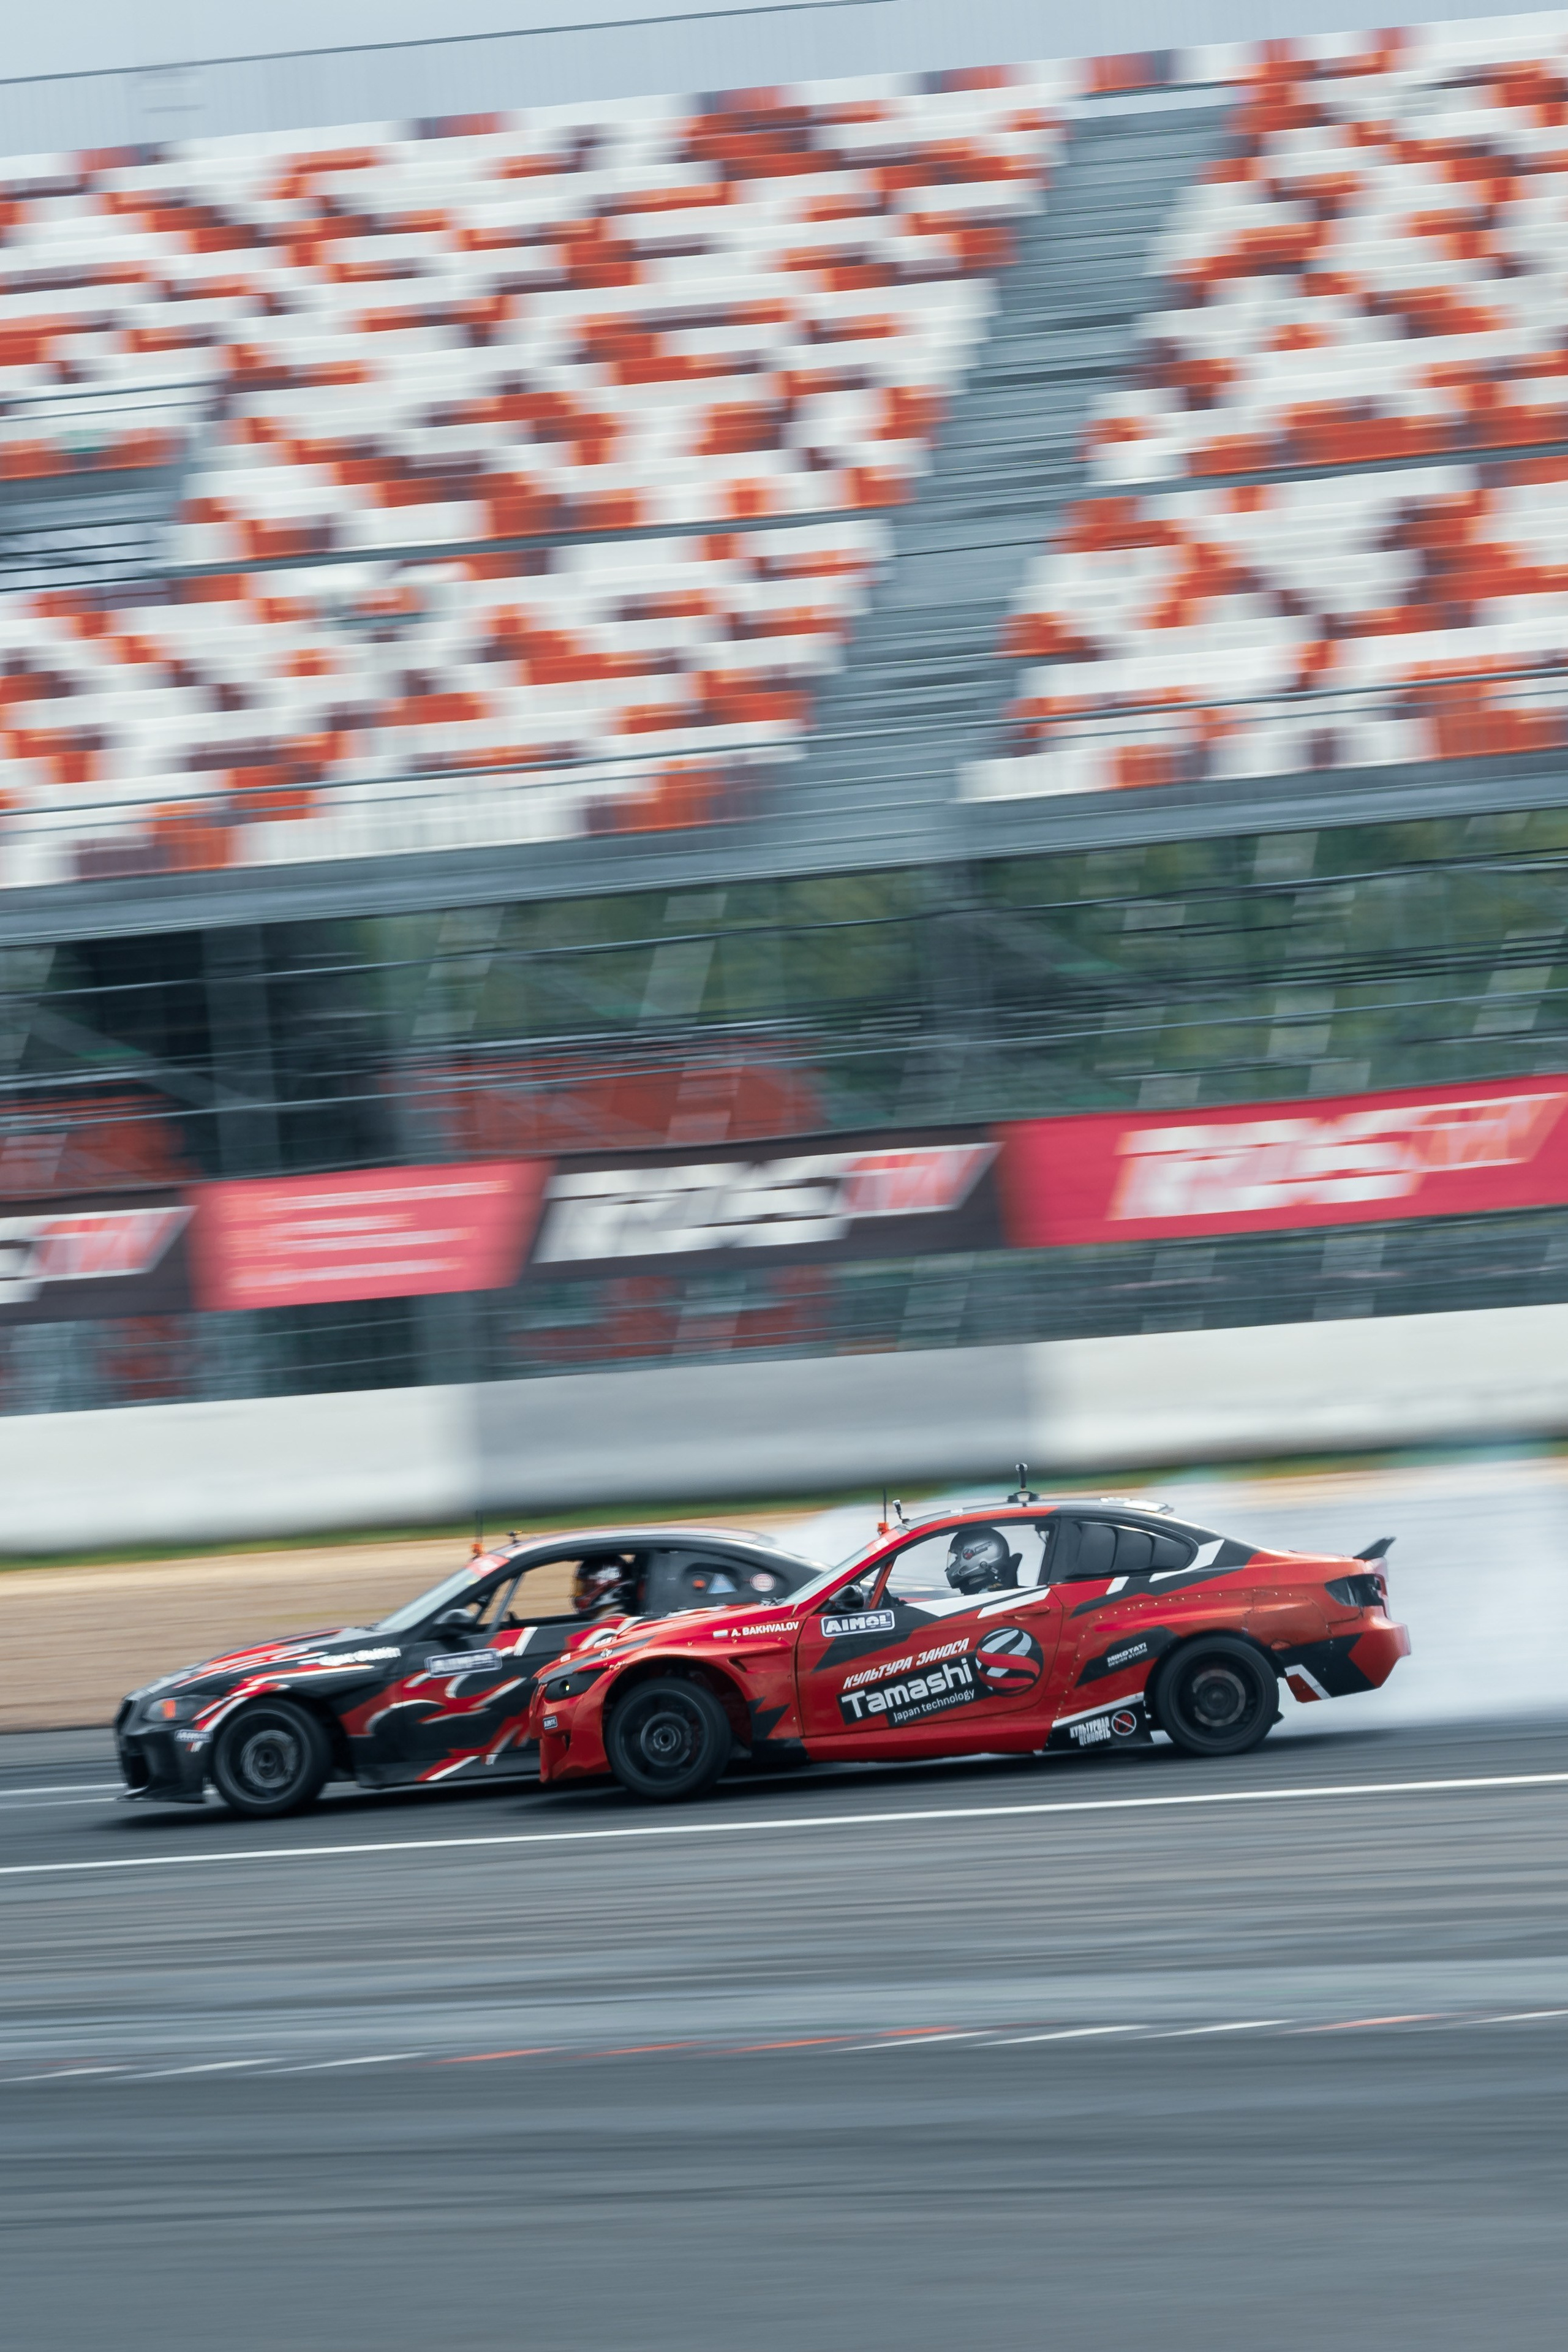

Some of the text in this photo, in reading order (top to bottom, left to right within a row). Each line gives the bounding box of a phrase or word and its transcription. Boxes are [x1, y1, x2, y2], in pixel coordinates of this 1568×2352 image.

[731, 1621, 799, 1637] A. BAKHVALOV
[826, 1615, 891, 1634] AIMOL
[843, 1637, 970, 1689] КУЛЬТУРА ЗАНОСА
[841, 1657, 973, 1718] Tamashi
[893, 1689, 975, 1723] Japan technology
